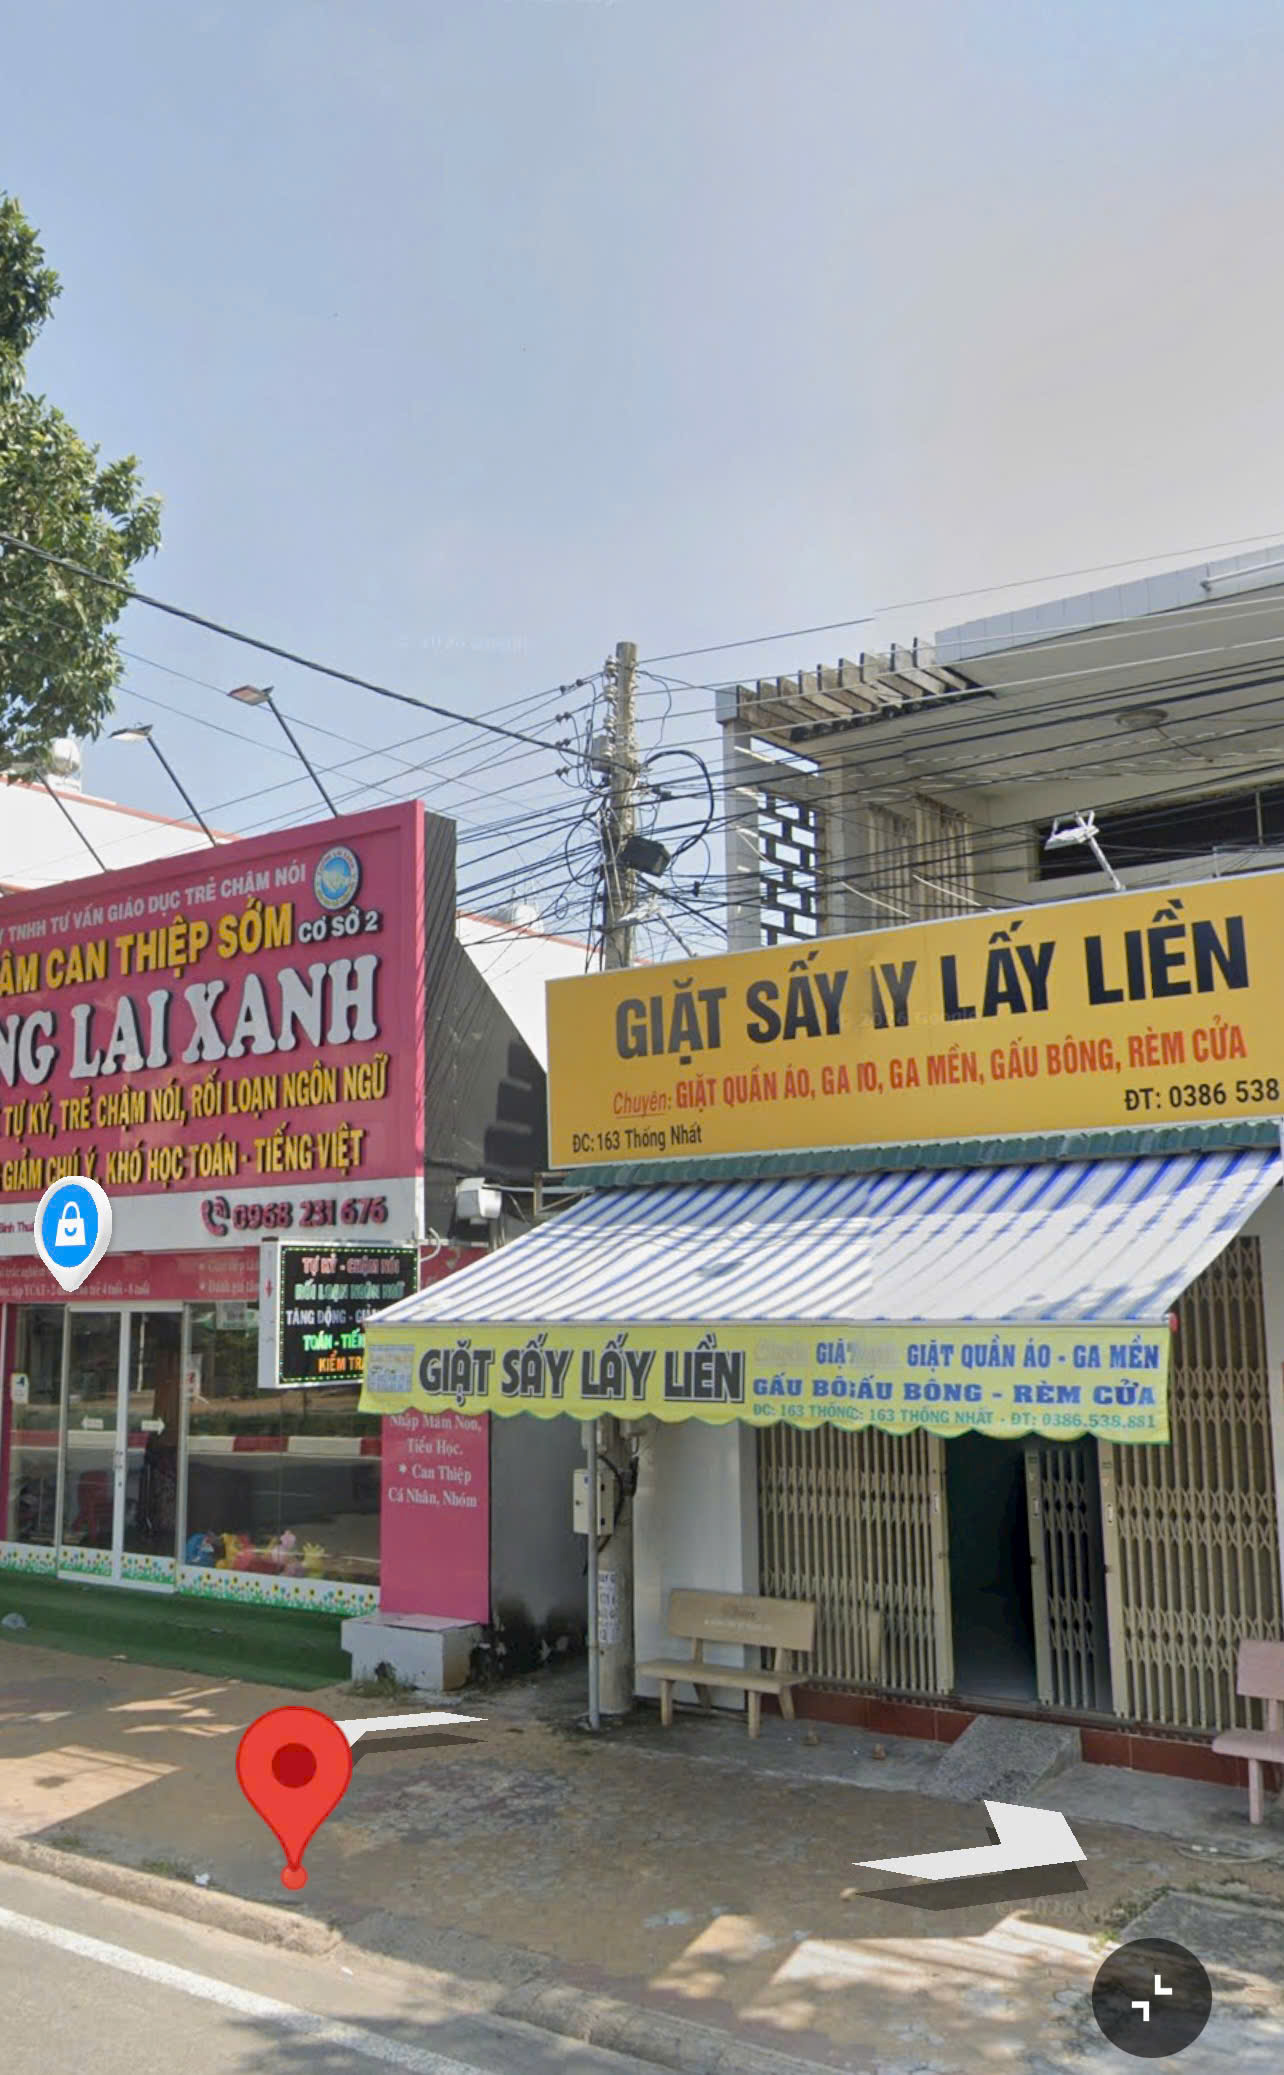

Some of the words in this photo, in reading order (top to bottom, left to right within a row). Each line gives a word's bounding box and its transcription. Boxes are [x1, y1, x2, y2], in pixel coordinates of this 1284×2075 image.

[8, 919, 47, 943] TNHH
[51, 911, 71, 934] TƯ
[73, 903, 104, 929] VẤN
[108, 896, 145, 923] GIÁO
[149, 890, 181, 917] DỤC
[185, 876, 216, 905] TRẺ
[220, 869, 270, 899] CHẬM
[275, 859, 306, 888] NÓI
[46, 939, 107, 989] CAN
[115, 914, 210, 979] THIỆP
[218, 896, 294, 959] SỚM
[298, 915, 327, 944] CƠ
[331, 905, 361, 937] SỞ
[365, 910, 379, 932] 2
[70, 988, 170, 1079] LAI
[182, 954, 380, 1065] XANH
[615, 976, 728, 1066] GIẶT
[745, 950, 849, 1045] SẤY
[940, 920, 1056, 1022] LẤY
[1084, 899, 1250, 1006] LIỀN
[3, 1100, 27, 1143] TỰ
[60, 1084, 91, 1131] TRẺ
[97, 1083, 146, 1132] CHẬM
[151, 1078, 187, 1126] NÓI,
[191, 1067, 223, 1118] RỐI
[227, 1074, 277, 1120] LOẠN
[283, 1059, 337, 1108] NGÔN
[344, 1052, 390, 1102] NGỮ
[613, 1090, 672, 1118] Chuyên:
[675, 1073, 718, 1112] GIẶT
[784, 1063, 816, 1100] ÁO,
[821, 1065, 851, 1096] GA
[889, 1057, 921, 1089] GA
[927, 1042, 985, 1086] MỀN,
[990, 1036, 1039, 1081] GẤU
[1046, 1034, 1122, 1076] BÔNG,
[1127, 1027, 1186, 1068] RÈM
[1192, 1014, 1249, 1063] CỬA
[1124, 1087, 1162, 1111] ĐT:
[1169, 1082, 1227, 1108] 0386
[1235, 1078, 1280, 1103] 538
[3, 1148, 43, 1192] GIẢM
[106, 1140, 144, 1185] KHÓ
[148, 1145, 184, 1189] HỌC
[190, 1133, 237, 1178] TOÁN
[255, 1121, 313, 1174] TIẾNG
[317, 1121, 365, 1176] VIỆT
[572, 1132, 594, 1153] ĐC:
[597, 1130, 620, 1151] 163
[624, 1125, 666, 1151] Thống
[670, 1121, 703, 1145] Nhất
[232, 1201, 294, 1229] 0968
[300, 1198, 337, 1227] 231
[341, 1196, 389, 1225] 676
[419, 1337, 496, 1408] GIẶT
[500, 1331, 574, 1399] SẤY
[579, 1331, 657, 1401] LẤY
[662, 1332, 746, 1404] LIỀN
[752, 1371, 803, 1397] GẤU
[903, 1378, 983, 1403] BÔNG
[1013, 1380, 1081, 1405] RÈM
[1092, 1378, 1157, 1406] CỬA
[906, 1339, 955, 1373] GIẶT
[1022, 1337, 1051, 1369] ÁO
[1071, 1344, 1101, 1369] GA
[780, 1403, 805, 1418] 163
[869, 1408, 896, 1422] 163
[411, 1463, 435, 1480] Can
